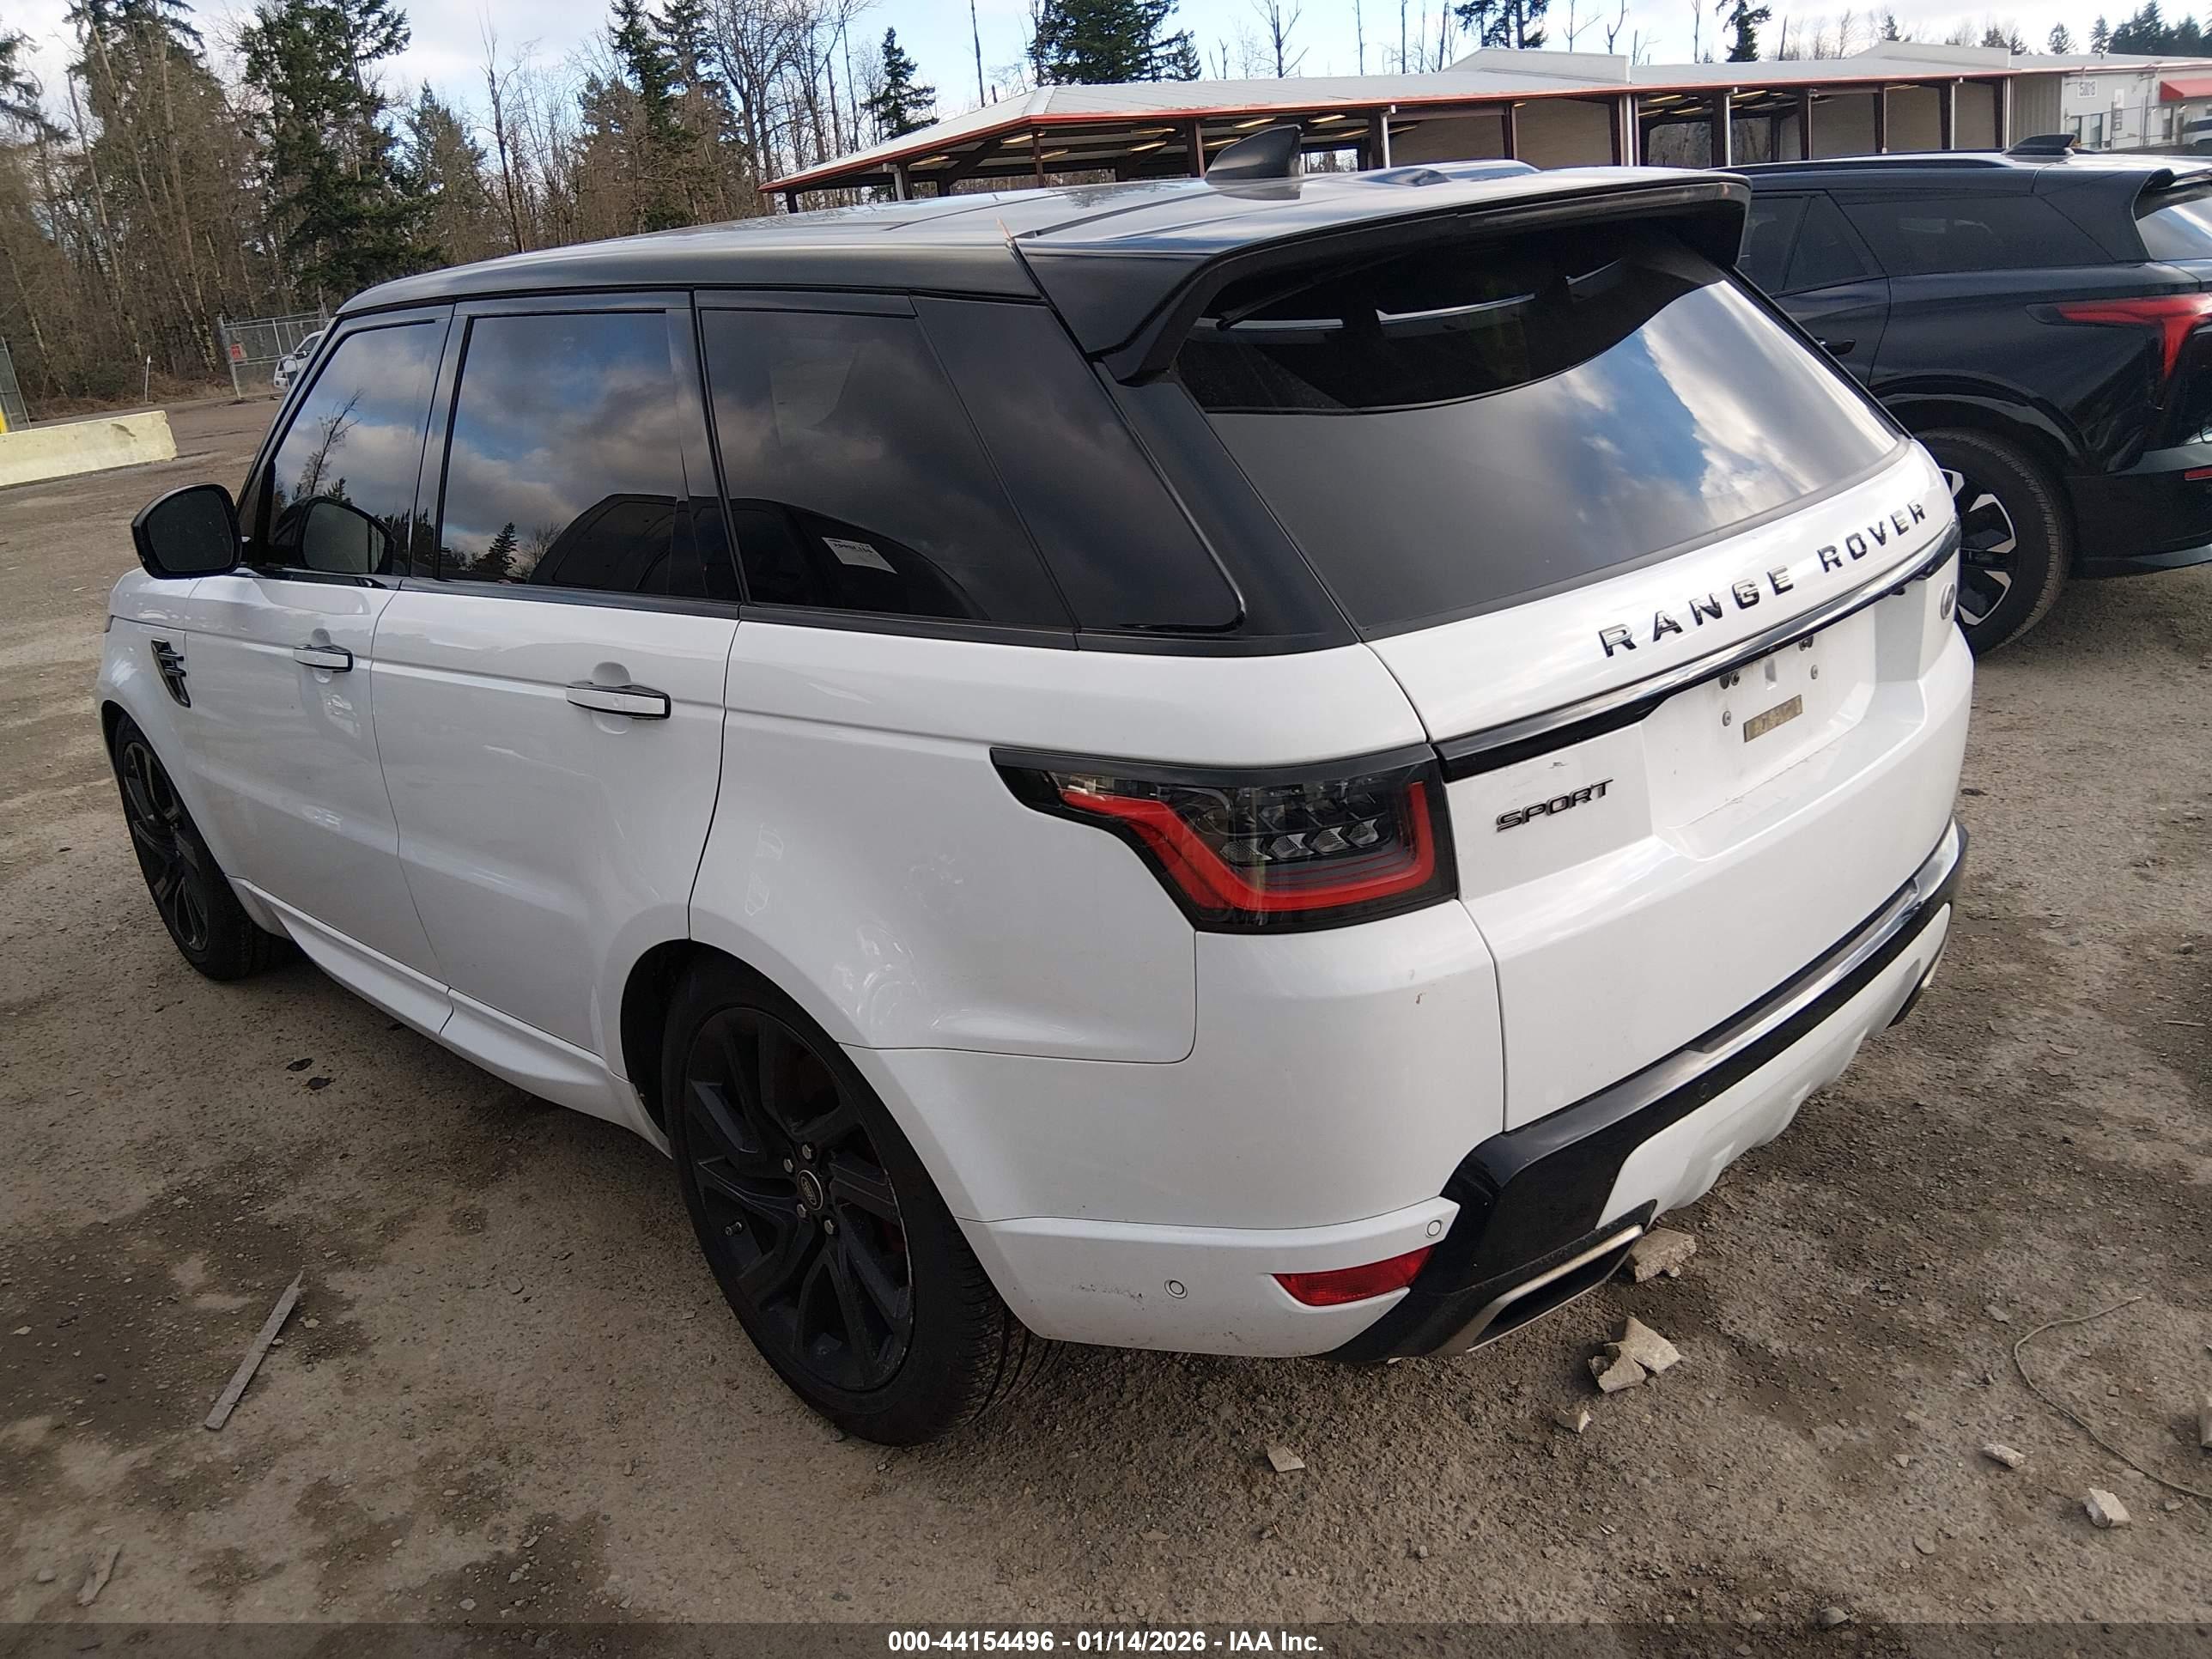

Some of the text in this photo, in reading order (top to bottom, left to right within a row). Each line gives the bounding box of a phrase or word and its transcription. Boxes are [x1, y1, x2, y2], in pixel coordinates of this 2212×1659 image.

[1599, 500, 1926, 657] RANGE ROVER
[1496, 776, 1613, 832] SPORT
